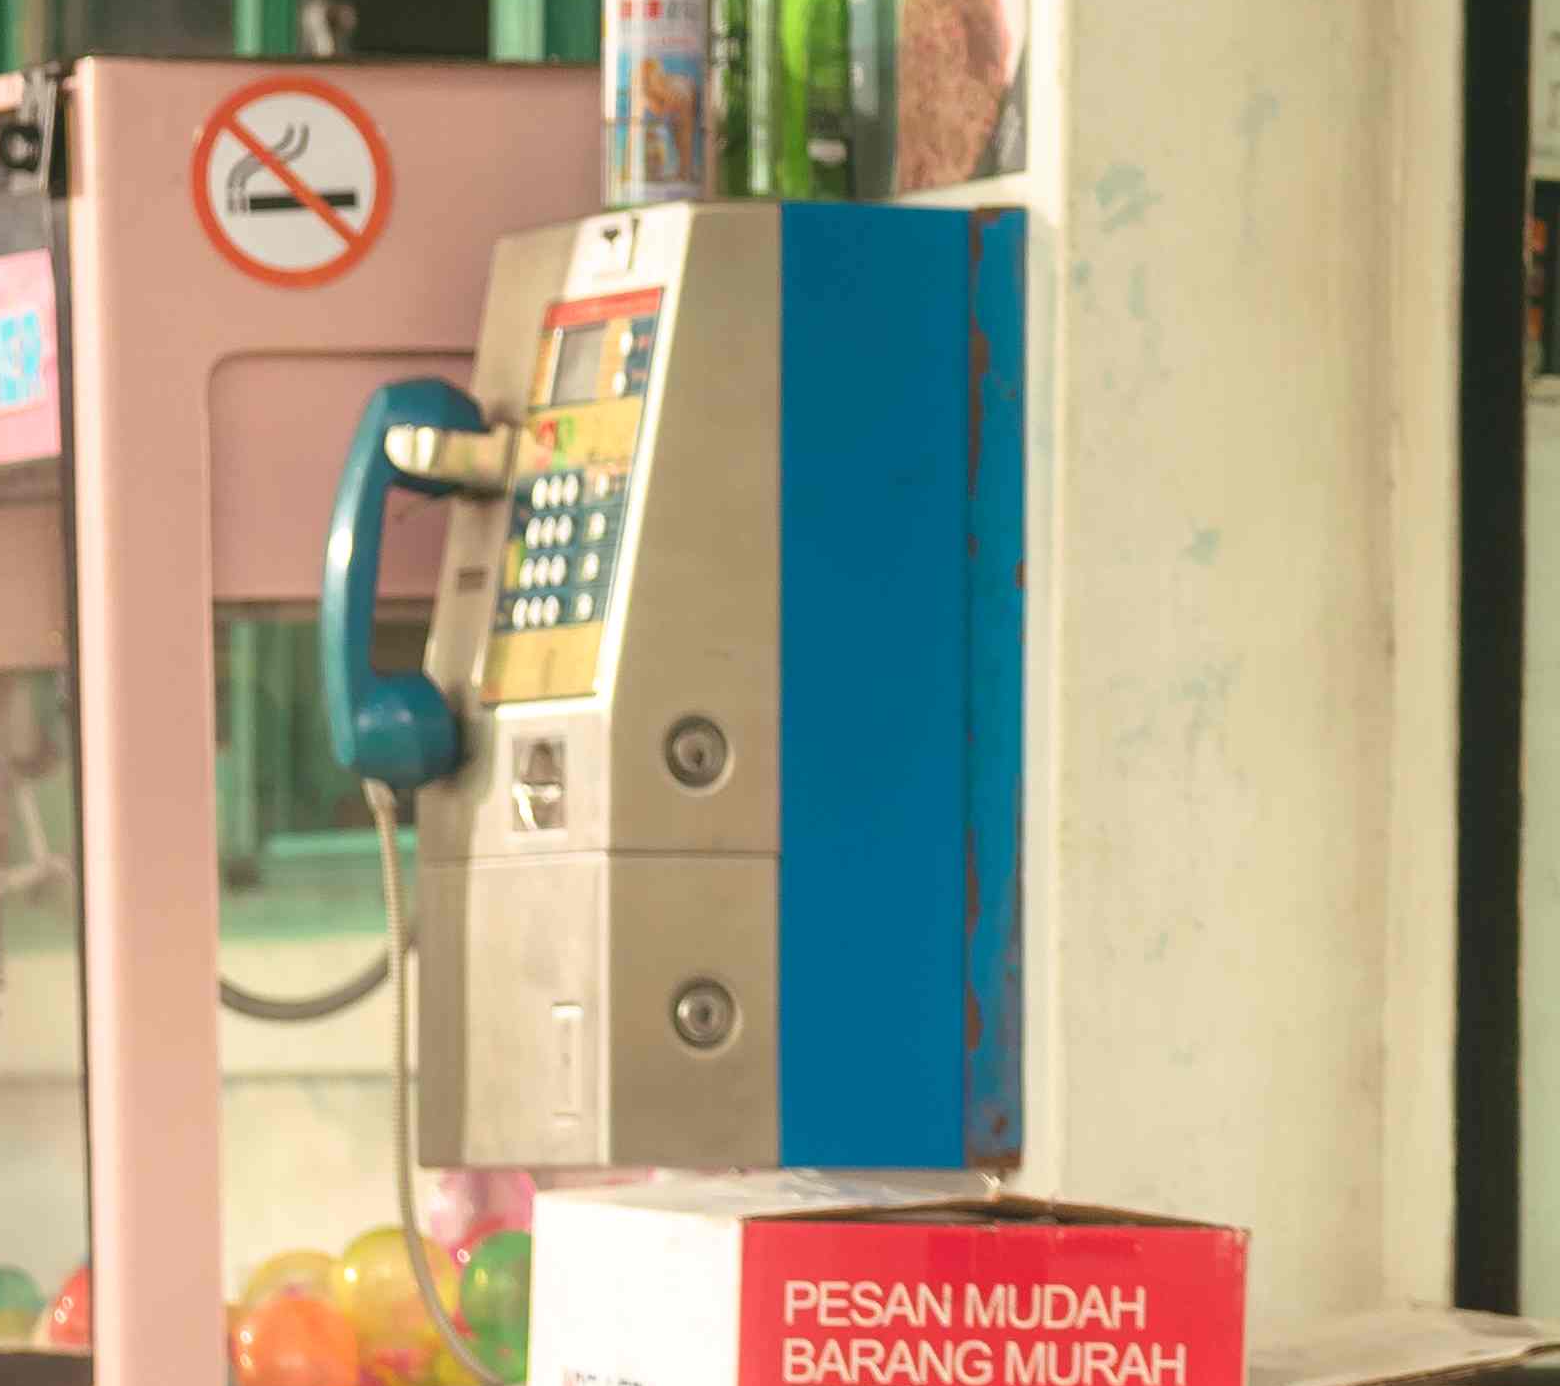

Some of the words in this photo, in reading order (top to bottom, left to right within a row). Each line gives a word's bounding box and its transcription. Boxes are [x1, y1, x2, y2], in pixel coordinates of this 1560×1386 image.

[782, 1280, 952, 1328] PESAN
[966, 1284, 1146, 1329] MUDAH
[782, 1339, 994, 1386] BARANG
[1005, 1341, 1187, 1386] MURAH
